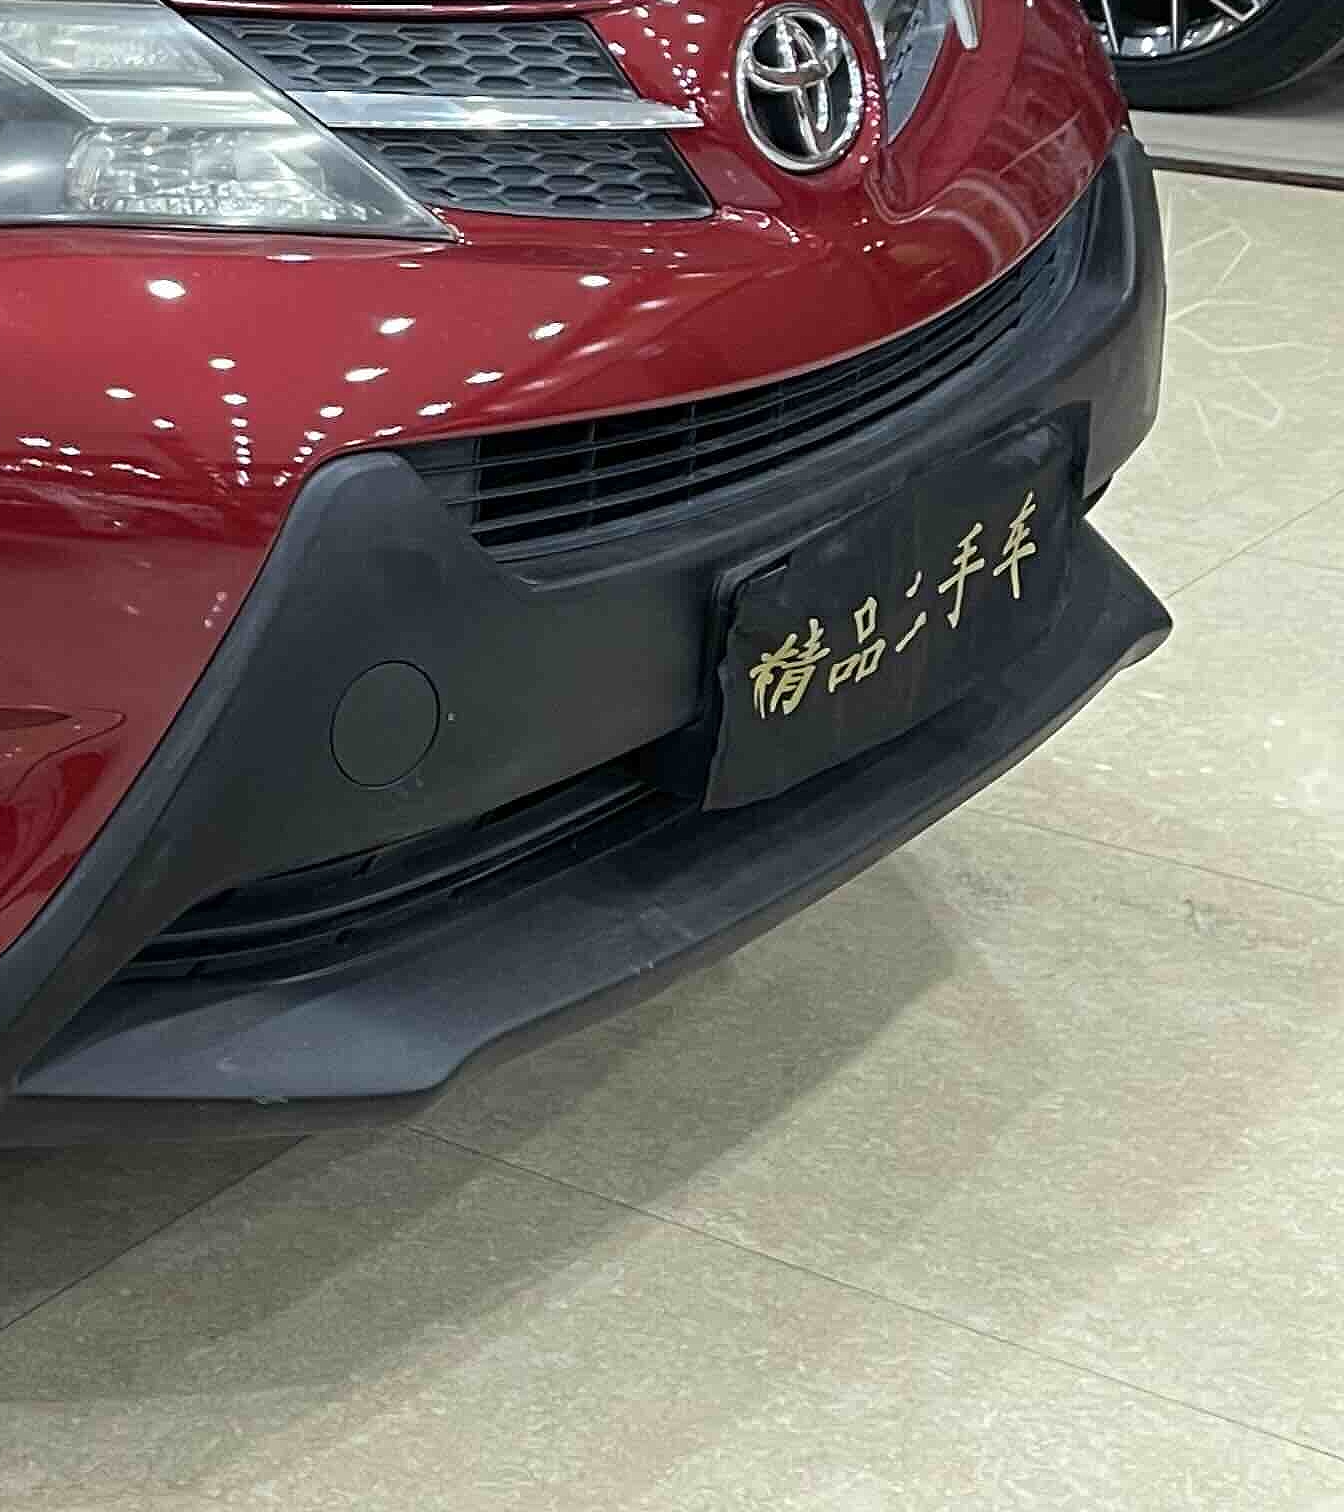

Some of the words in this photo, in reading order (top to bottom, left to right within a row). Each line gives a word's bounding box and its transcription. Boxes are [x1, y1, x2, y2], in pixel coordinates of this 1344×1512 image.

[749, 491, 1038, 719] 精品二手车
